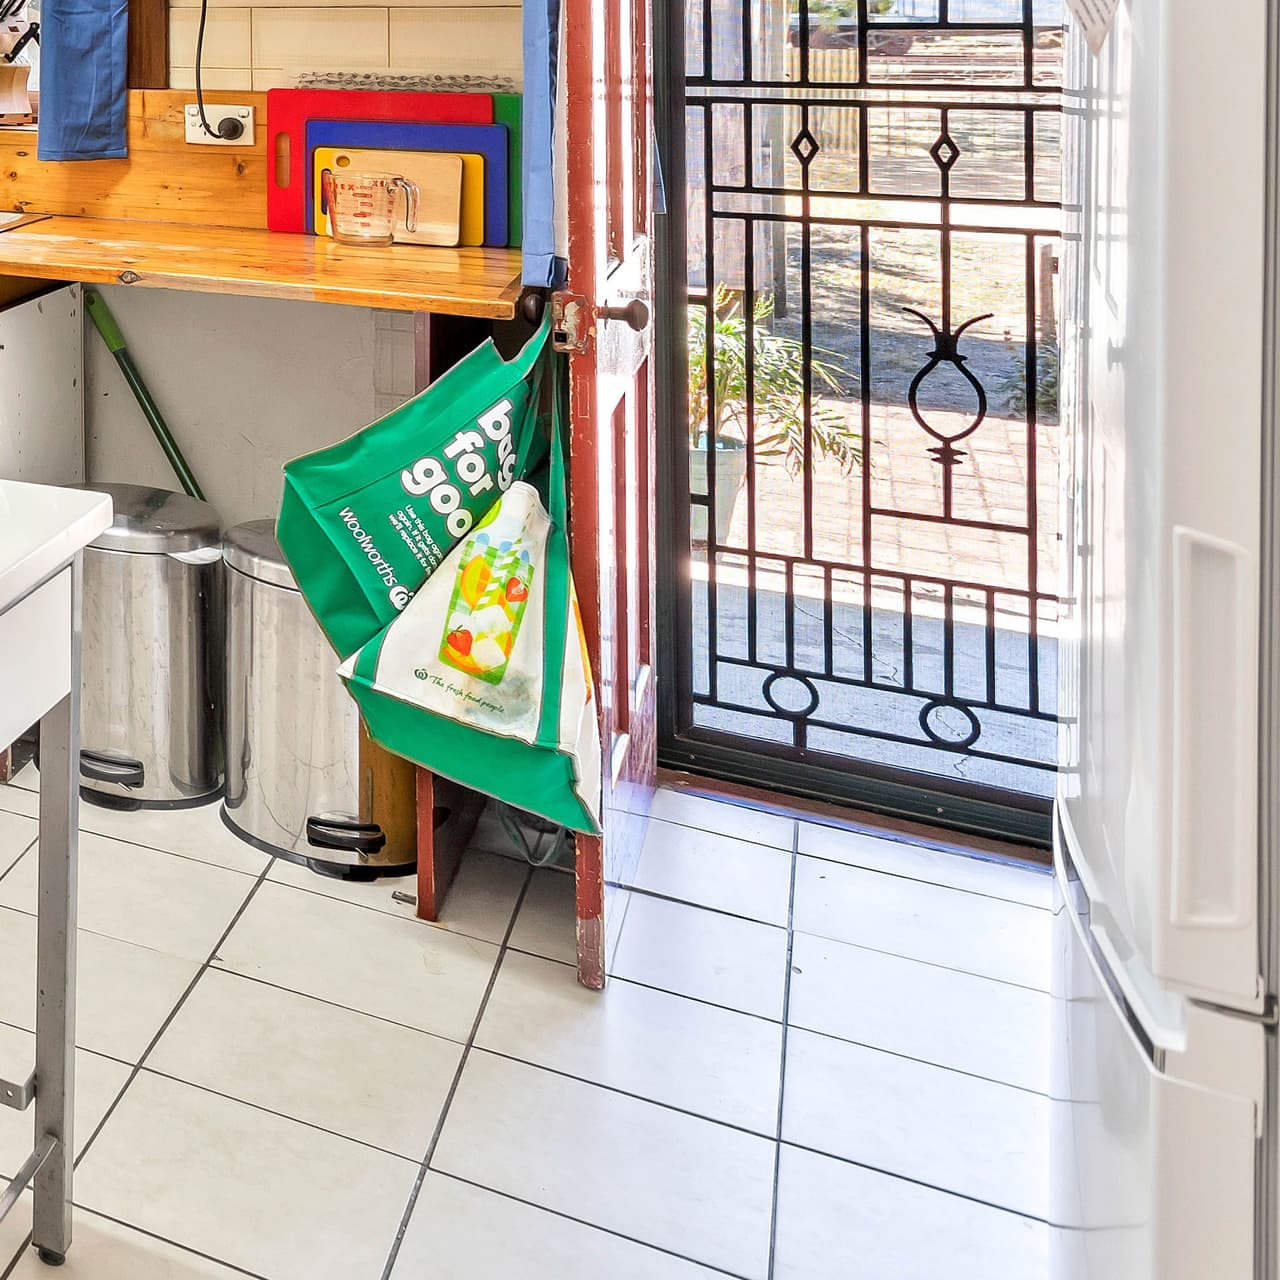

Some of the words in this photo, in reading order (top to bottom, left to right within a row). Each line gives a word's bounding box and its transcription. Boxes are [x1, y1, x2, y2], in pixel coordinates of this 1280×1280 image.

[443, 429, 494, 497] for
[400, 456, 473, 539] goo
[405, 504, 417, 519] Use
[422, 529, 434, 545] bag
[429, 674, 445, 688] The
[444, 683, 463, 697] fresh
[463, 691, 483, 703] food
[479, 700, 505, 713] people
